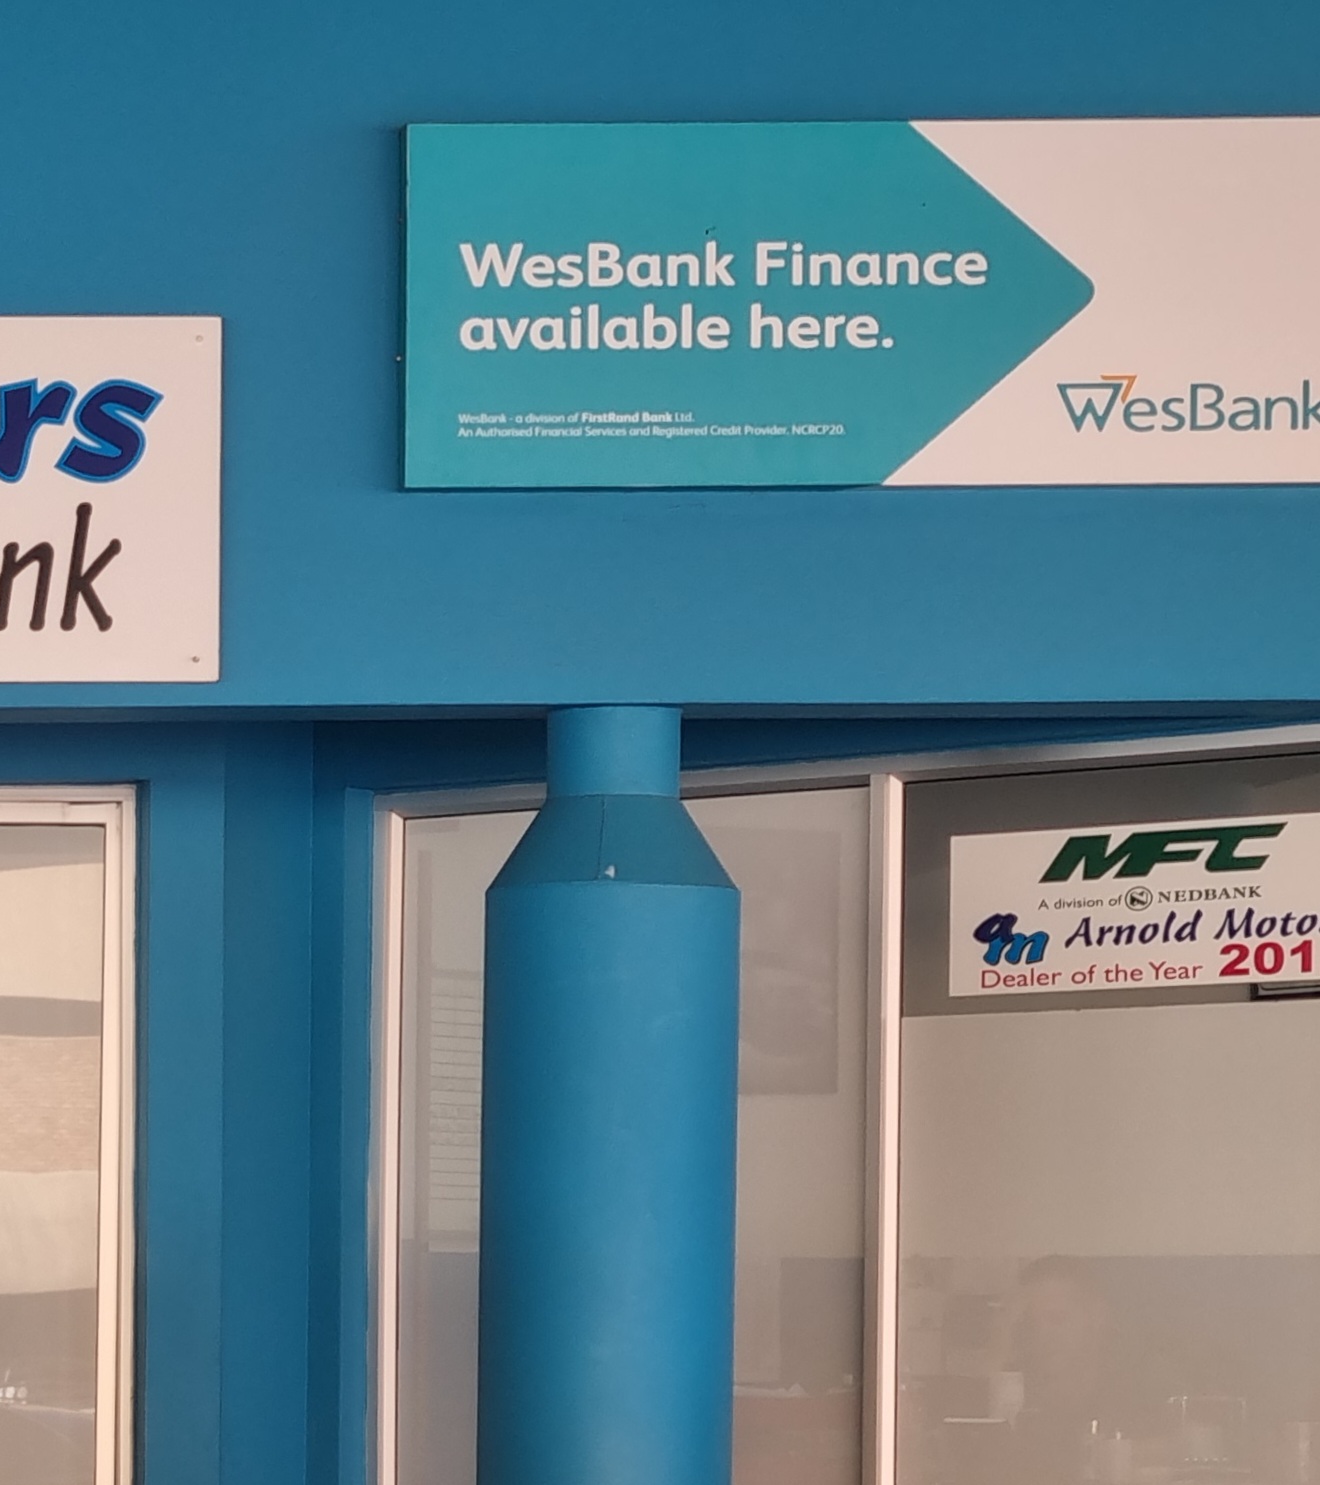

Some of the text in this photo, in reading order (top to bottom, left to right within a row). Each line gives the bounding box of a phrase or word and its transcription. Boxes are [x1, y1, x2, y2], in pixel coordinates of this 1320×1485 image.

[460, 241, 989, 288] WesBank Finance
[460, 303, 895, 352] available here.
[457, 413, 507, 424] WesBank
[515, 414, 523, 424] a
[524, 412, 565, 424] division
[567, 412, 579, 424] of
[581, 412, 640, 424] FirstRand
[642, 412, 673, 423] Bank
[674, 412, 695, 423] Ltd.
[1056, 375, 1320, 433] WesBank
[457, 427, 473, 437] An
[475, 426, 533, 437] Authorised
[534, 426, 582, 437] Financial
[584, 426, 627, 437] Services
[629, 426, 650, 436] and
[652, 425, 708, 438] Registered
[710, 425, 742, 436] Credit
[1038, 822, 1288, 884] MFC
[1037, 885, 1263, 910] A division of NEDBANK
[1064, 907, 1320, 948] Arnold Moto
[980, 968, 1062, 989] Dealer
[1071, 964, 1098, 985] of
[1104, 963, 1144, 984] the
[1148, 960, 1203, 981] Year
